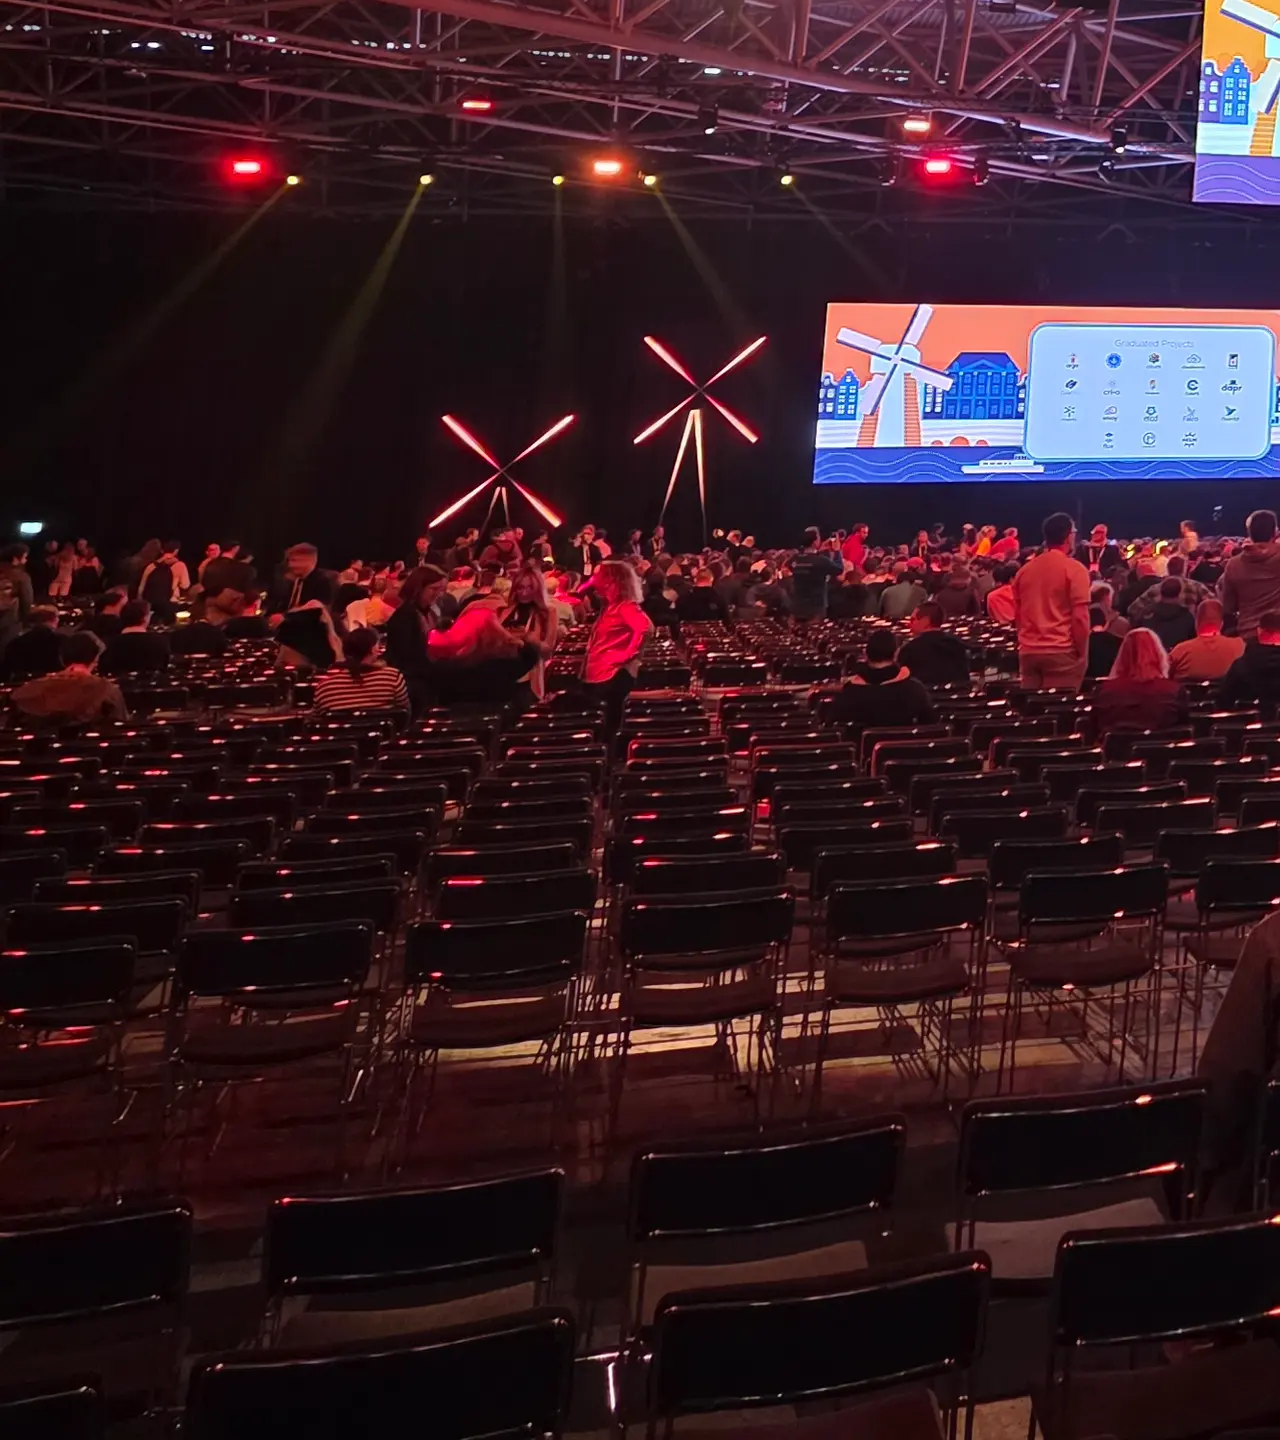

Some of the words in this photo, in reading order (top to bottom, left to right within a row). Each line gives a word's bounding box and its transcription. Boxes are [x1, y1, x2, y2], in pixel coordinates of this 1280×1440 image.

[1114, 339, 1159, 348] Graduated
[1161, 340, 1194, 349] Projects
[1221, 384, 1243, 395] dapr
